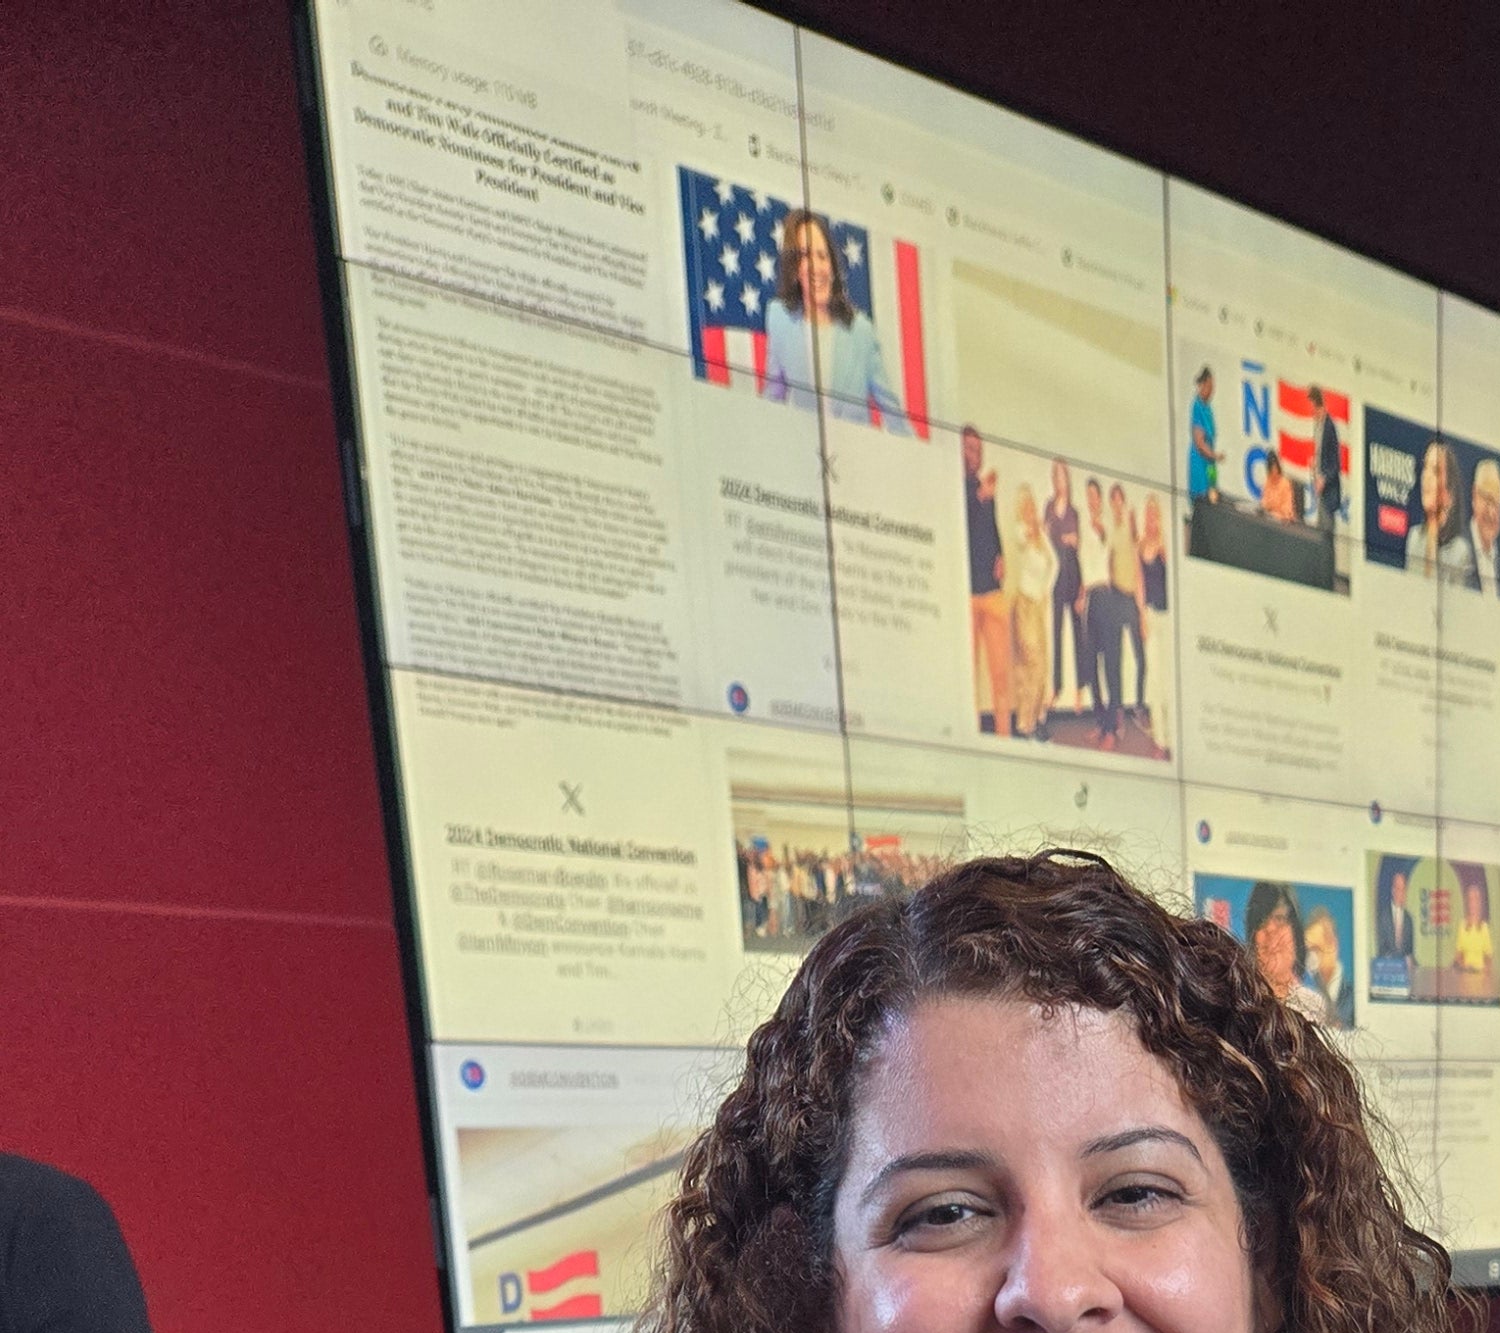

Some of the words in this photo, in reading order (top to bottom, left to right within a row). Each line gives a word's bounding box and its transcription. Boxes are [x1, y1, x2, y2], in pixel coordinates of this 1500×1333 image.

[353, 106, 437, 147] Democratic
[530, 166, 590, 199] President
[481, 128, 541, 162] Officially
[543, 147, 600, 180] Certified
[475, 167, 540, 202] President
[821, 502, 871, 527] ational
